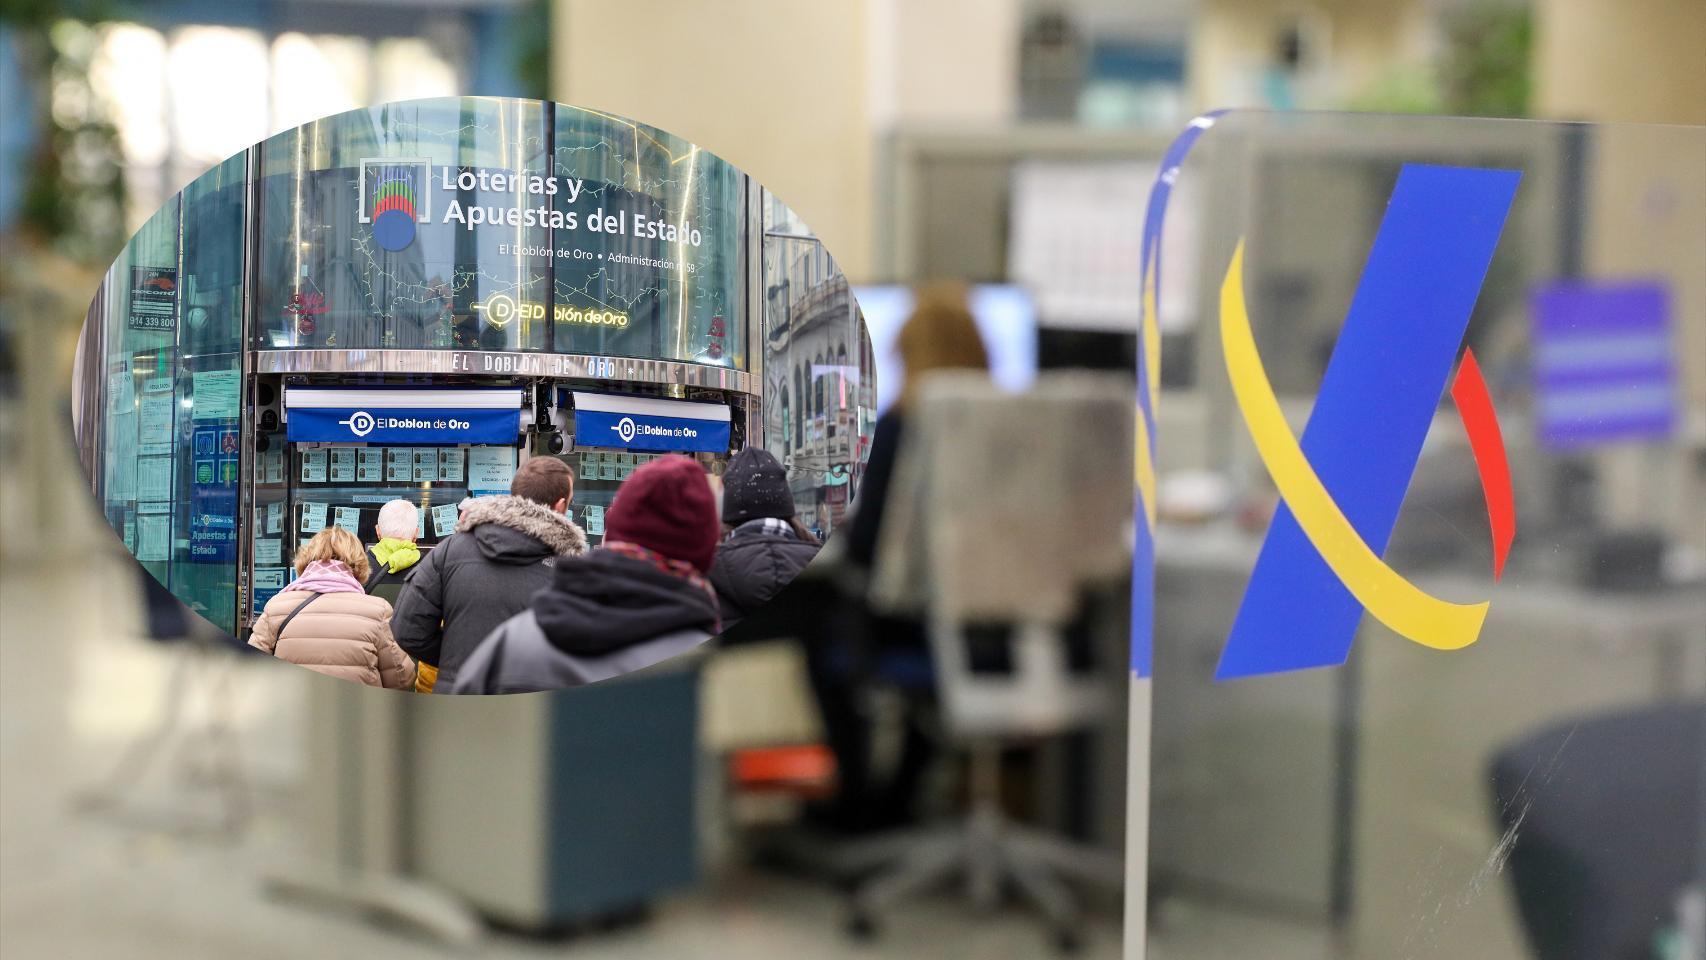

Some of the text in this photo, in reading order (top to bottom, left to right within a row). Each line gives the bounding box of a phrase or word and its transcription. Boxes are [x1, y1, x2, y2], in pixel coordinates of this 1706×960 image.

[566, 178, 583, 203] y
[442, 199, 702, 247] Apuestas del Estado
[499, 244, 593, 260] El Doblón de Oro
[607, 252, 674, 270] Administración
[130, 316, 175, 328] 914 339 800
[519, 304, 628, 326] El Dblón de Oro
[452, 353, 469, 371] EL
[554, 358, 570, 375] DE
[588, 360, 615, 377] ORO
[377, 418, 388, 429] El
[389, 418, 431, 429] Doblon
[433, 418, 447, 429] de
[448, 418, 470, 430] Oro
[645, 425, 673, 437] Doblon
[673, 427, 682, 437] de
[683, 427, 697, 438] Oro
[192, 530, 227, 542] Apuestas
[192, 545, 217, 555] Estado
